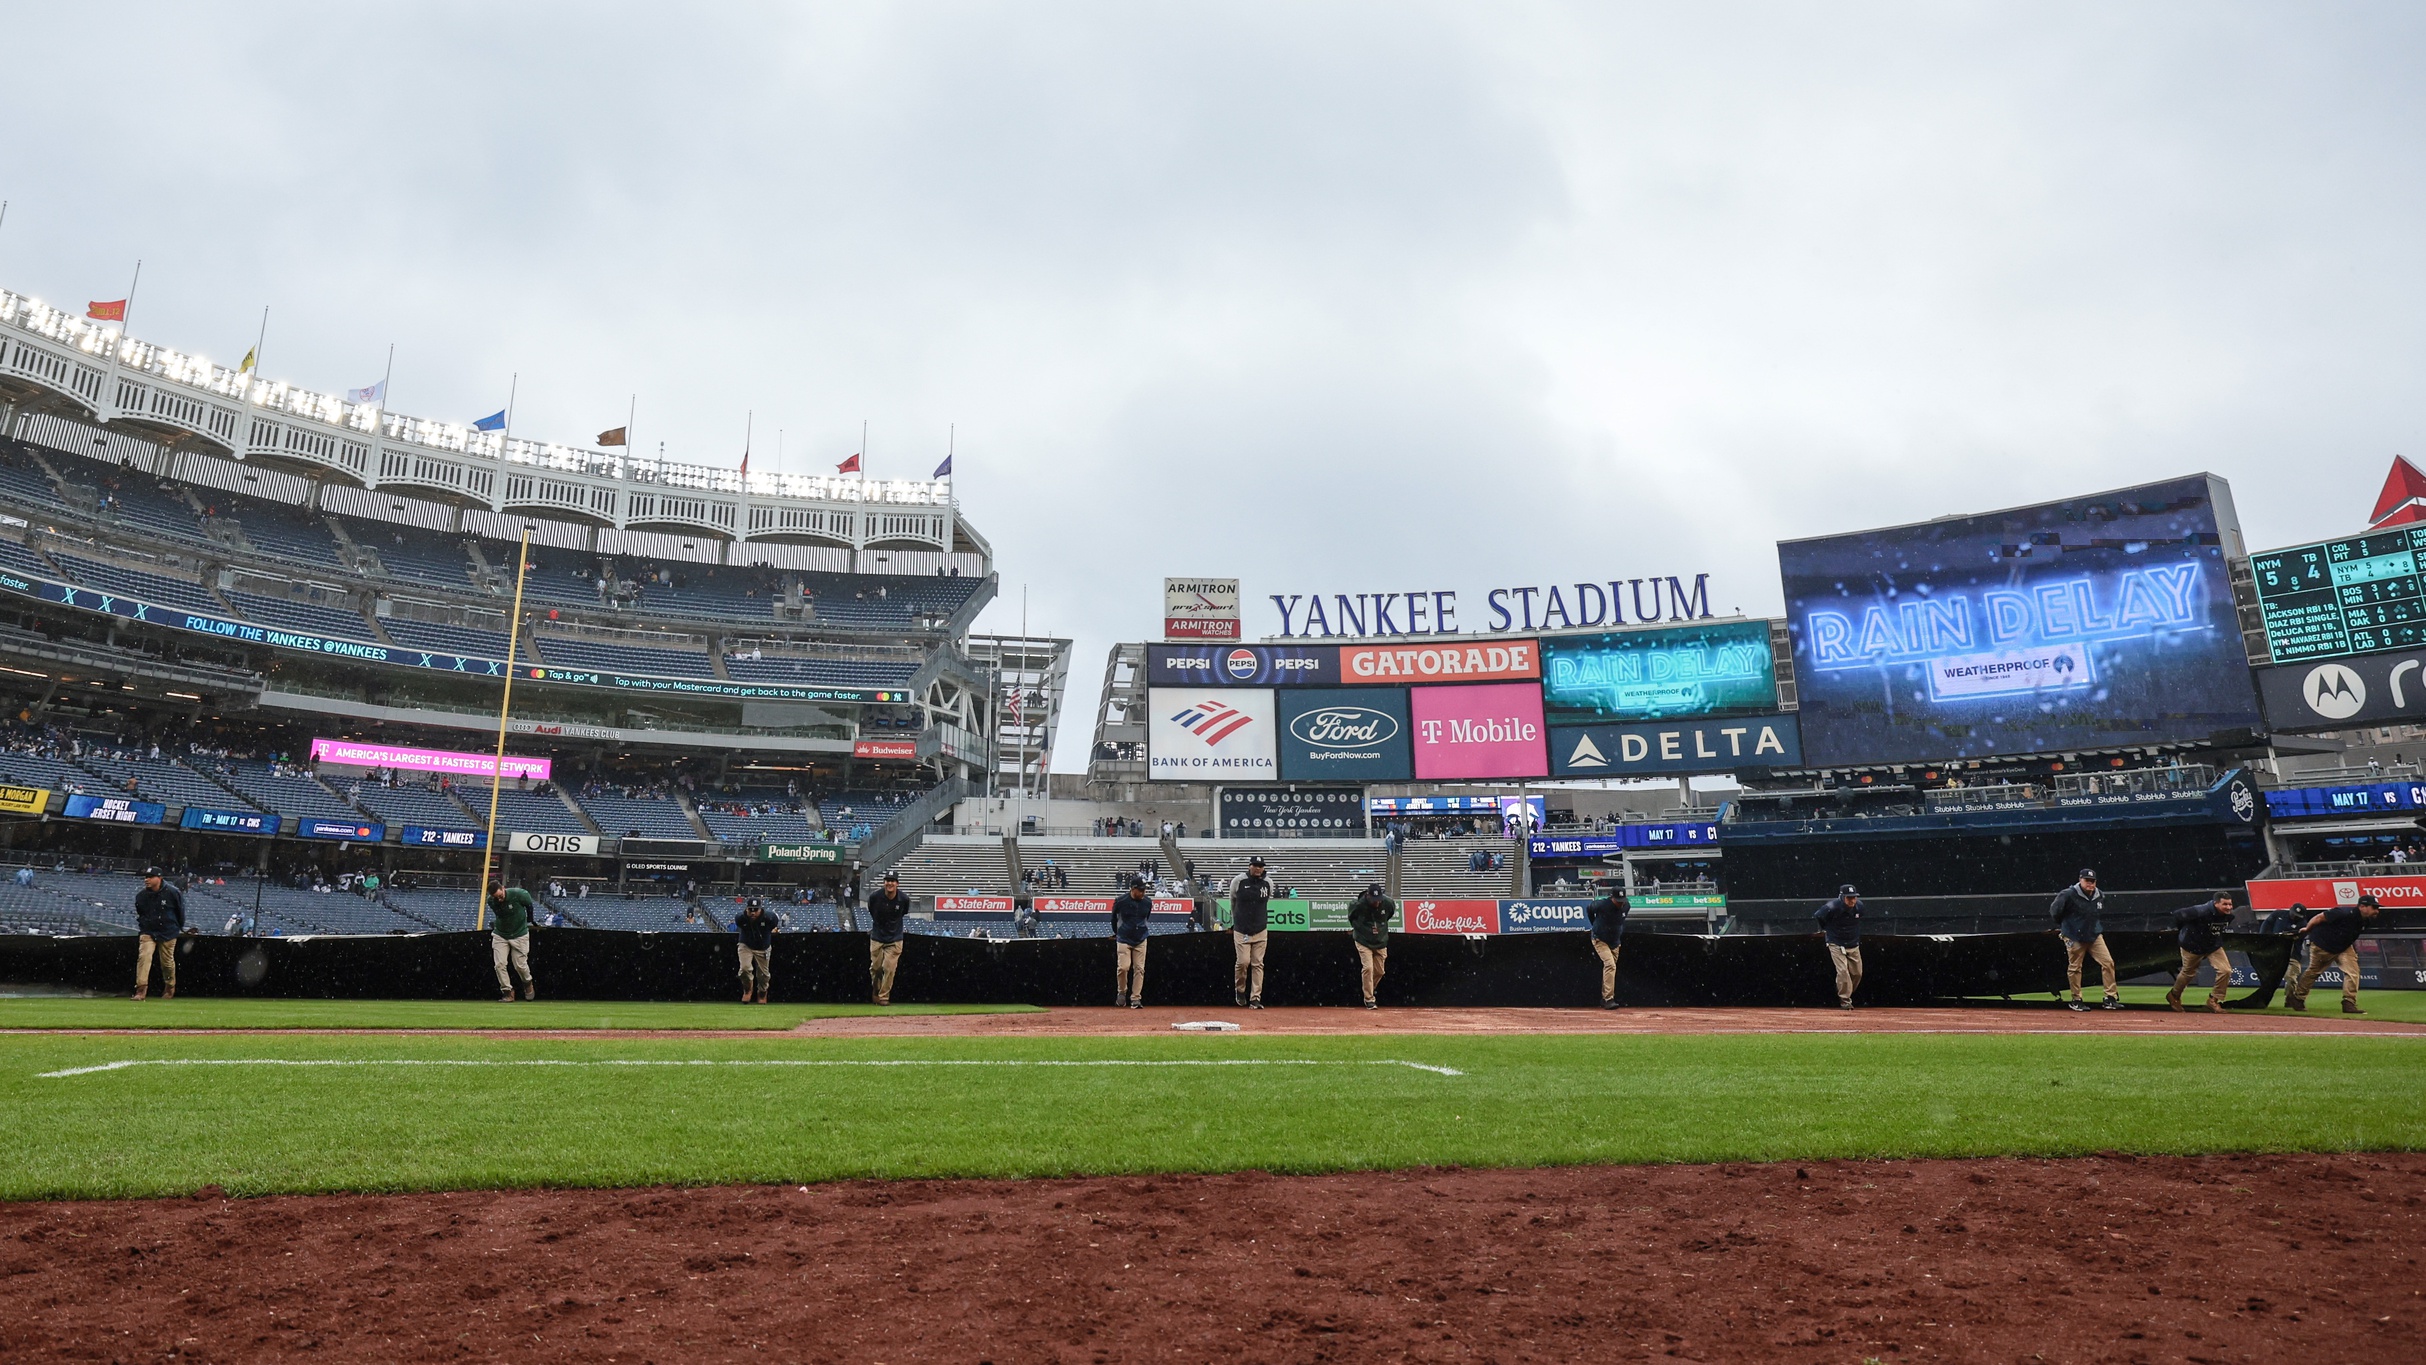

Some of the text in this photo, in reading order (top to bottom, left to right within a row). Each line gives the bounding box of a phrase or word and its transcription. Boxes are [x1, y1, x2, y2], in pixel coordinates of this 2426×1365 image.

[2332, 544, 2350, 552] COL
[2360, 540, 2366, 548] 3
[2334, 548, 2368, 561] PIT 5
[2257, 553, 2317, 570] NYM TB
[2266, 564, 2320, 585] 5 8 4
[2337, 564, 2358, 574] NYM
[0, 574, 29, 591] faster.
[2339, 574, 2351, 582] TB
[1168, 584, 1236, 594] ARMITRON
[2342, 587, 2362, 596] BOS
[2344, 592, 2379, 604] MIN 1
[1269, 573, 1714, 638] YANKEE STADIUM
[1808, 562, 2200, 665] RAIN DELAY
[2267, 608, 2304, 619] JACKSON
[2306, 606, 2321, 614] RBI
[2348, 609, 2367, 618] MIA
[2377, 606, 2384, 614] 4
[1172, 621, 1233, 630] ARMITRON
[2269, 613, 2340, 628] DIAZ RBI SINGLE,
[2350, 617, 2370, 626] OAK
[186, 616, 388, 660] FOLLOW THE YANKEES @YANKEES
[2271, 627, 2304, 637] DeLUCA
[2291, 634, 2321, 644] NAVAREZ
[2321, 632, 2334, 640] RBI
[2354, 632, 2372, 641] ATL
[2286, 645, 2315, 654] NIMMO
[2317, 642, 2332, 650] RBI
[2335, 640, 2346, 648] 1B
[2356, 640, 2375, 649] LAD
[1166, 658, 1210, 669] PEPSI
[1275, 659, 1319, 670] PEPSI
[1352, 646, 1530, 676] GATORADE
[1553, 645, 1755, 687] RAIN DELAY
[548, 670, 572, 680] Tap &
[615, 677, 630, 687] Tap
[673, 682, 721, 693] Mastercard
[741, 688, 756, 696] get
[758, 688, 778, 696] back
[807, 692, 832, 700] game
[834, 692, 861, 700] faster.
[1624, 688, 1680, 697] WEATHERPROOF
[535, 725, 620, 738] Audi YANKEES CLUB
[1309, 712, 1379, 741] Ford
[1449, 718, 1536, 744] Mobile
[1621, 726, 1785, 762] DELTA
[872, 746, 913, 755] Budweiser
[1310, 751, 1380, 760] BuyFordNow.com
[335, 748, 388, 760] AMERICA'S
[390, 753, 432, 765] LARGEST
[433, 757, 440, 765] &
[442, 757, 481, 769] FASTEST
[481, 761, 494, 770] 5G
[1152, 758, 1272, 767] BANK OF AMERICA
[2098, 795, 2129, 804] StubHub
[2135, 793, 2166, 801] StubHub
[2172, 790, 2203, 799] StubHub
[2332, 792, 2396, 806] MAY 17 VS
[103, 799, 130, 811] HOCKEY
[1965, 804, 1994, 812] StubHub
[1995, 802, 2024, 810] StubHub
[2060, 798, 2092, 806] StubHub
[90, 808, 137, 822] JERSEY NIGHT
[1262, 805, 1321, 816] New York Yankees
[1934, 805, 1962, 813] StubHub
[202, 814, 261, 827] FRI MAY 17 CWS
[315, 826, 352, 834] yankees.com
[1649, 829, 1696, 840] MAY 17 VS
[422, 830, 474, 844] 212 YANKEES
[527, 835, 581, 852] ORIS
[1533, 842, 1581, 852] 212 YANKEES
[768, 845, 836, 861] Poland Spring
[2363, 887, 2423, 898] TOYOTA
[1312, 902, 1348, 911] Morningside
[1267, 910, 1305, 925] Eats
[1416, 908, 1487, 932] Chick-fil-A
[1532, 906, 1584, 923] coupa
